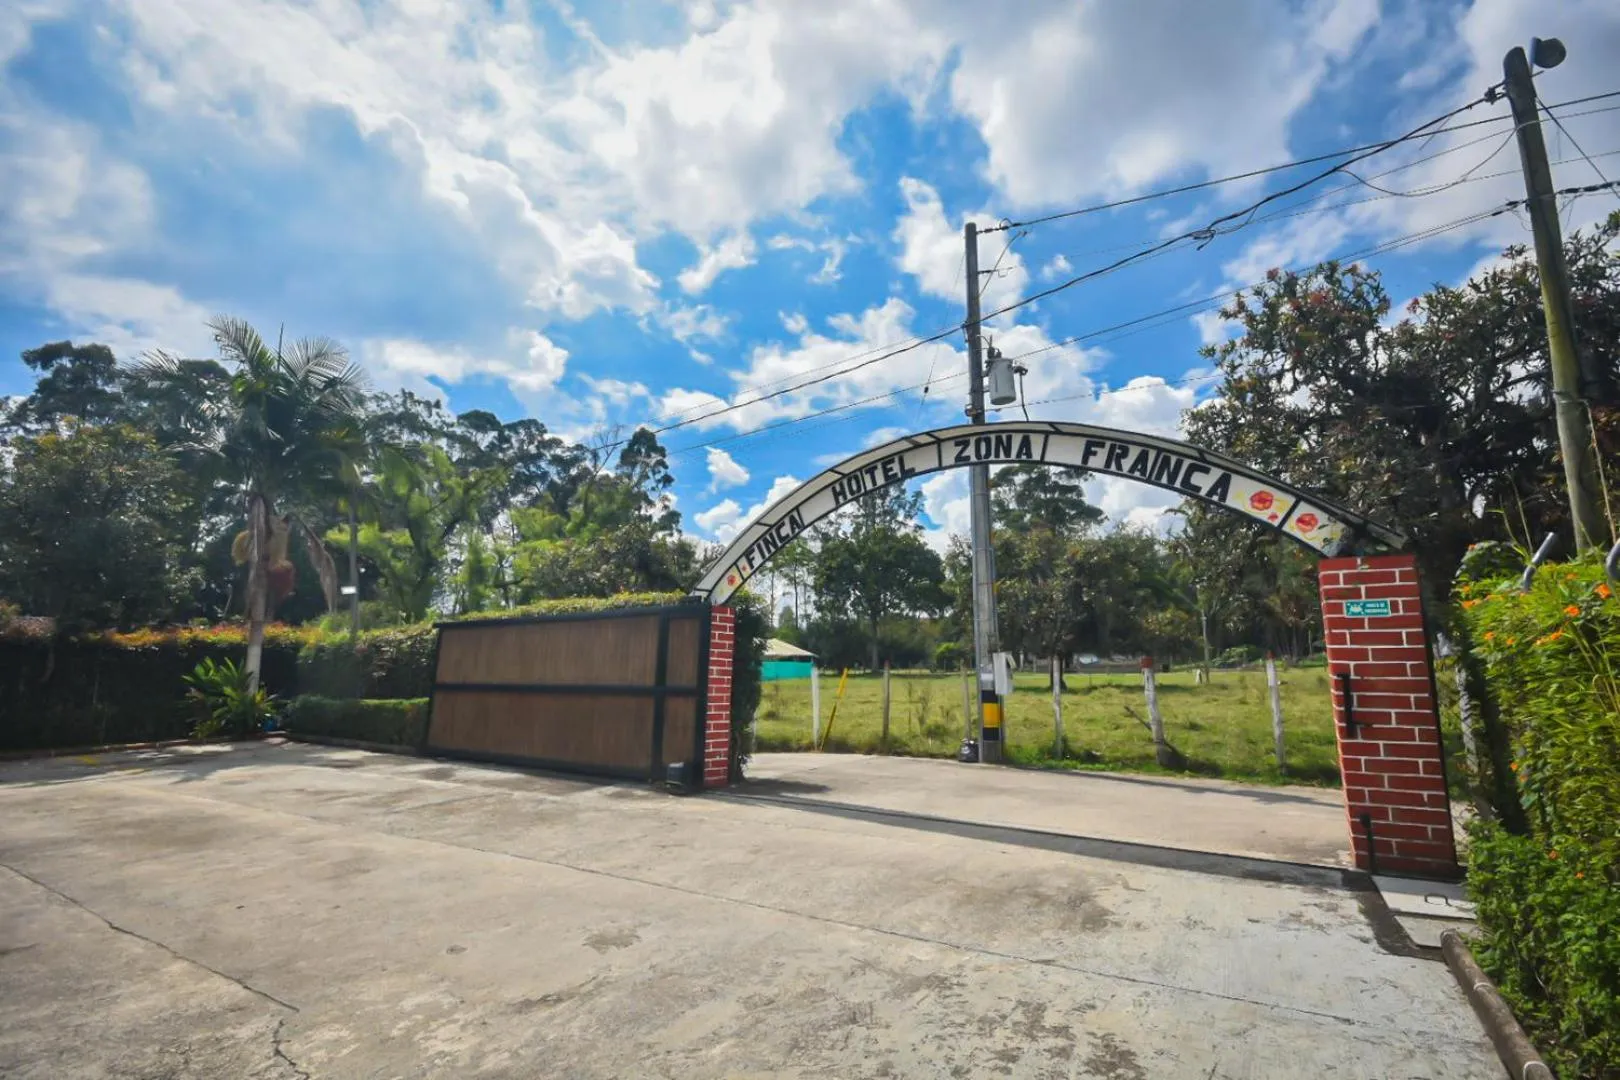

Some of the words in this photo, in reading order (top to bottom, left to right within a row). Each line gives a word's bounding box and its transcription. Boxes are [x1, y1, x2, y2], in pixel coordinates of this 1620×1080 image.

[743, 514, 801, 569] FINCA
[831, 455, 915, 506] HOTEL
[954, 434, 1032, 462] ZONA
[1081, 440, 1232, 503] FRANCA
